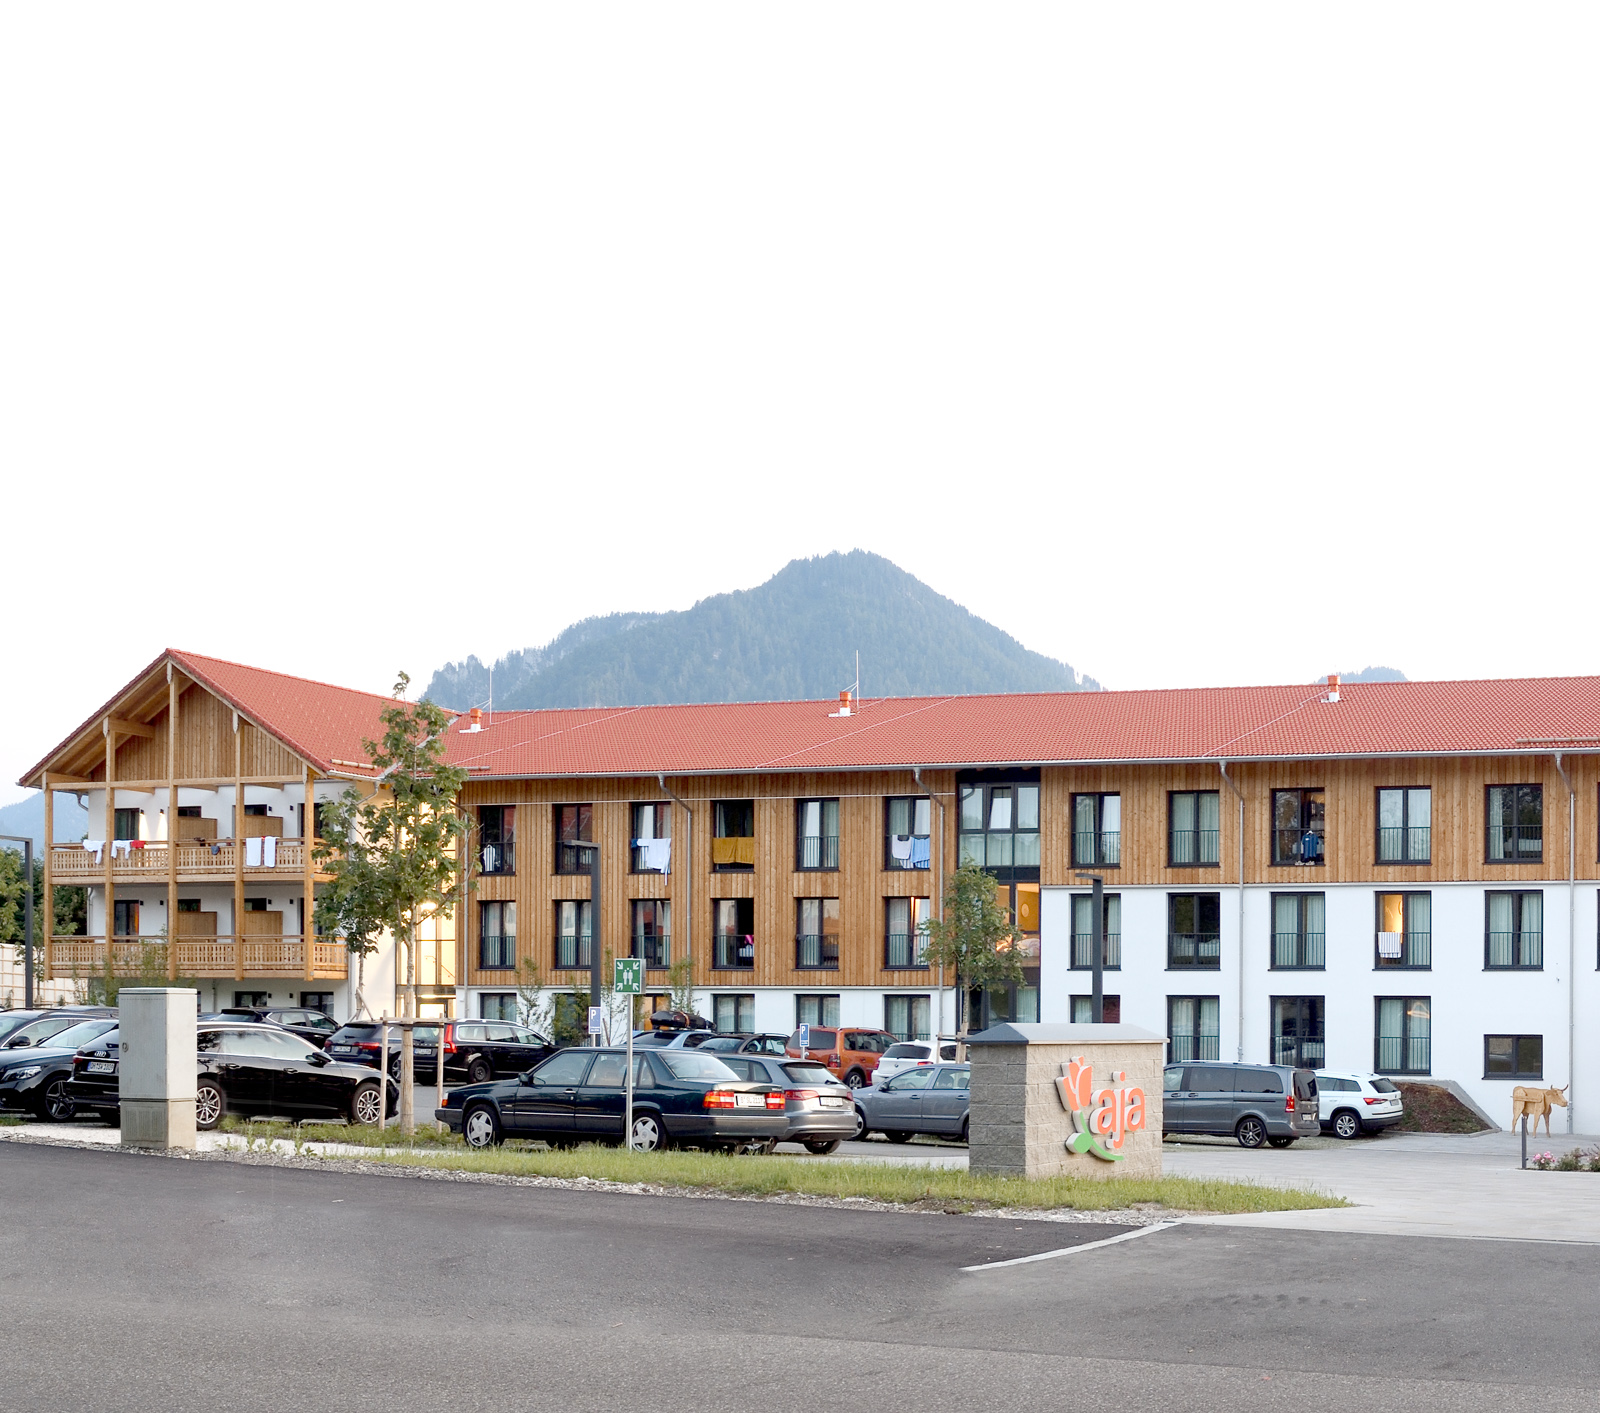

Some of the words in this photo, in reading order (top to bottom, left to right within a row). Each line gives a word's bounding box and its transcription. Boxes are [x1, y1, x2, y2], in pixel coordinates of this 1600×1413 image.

[590, 1010, 596, 1020] P
[801, 1026, 806, 1034] P
[1093, 1070, 1146, 1149] aja
